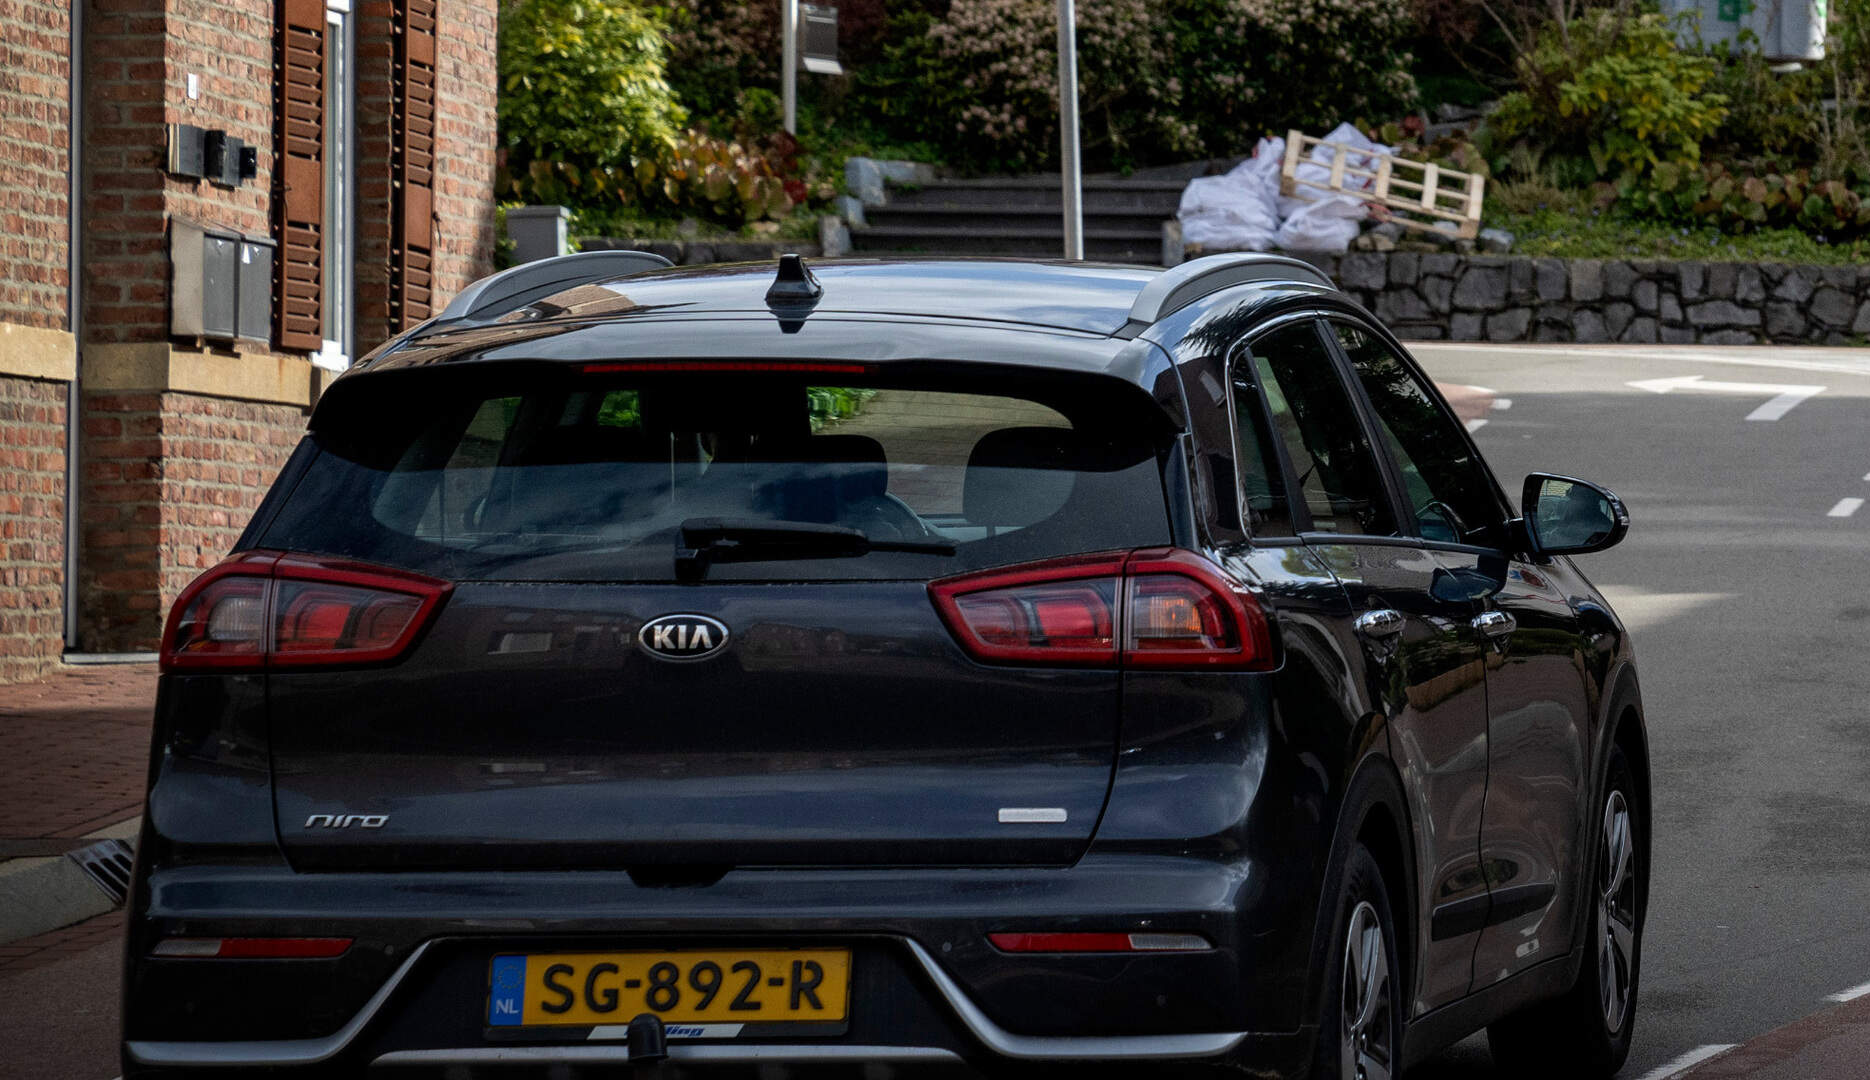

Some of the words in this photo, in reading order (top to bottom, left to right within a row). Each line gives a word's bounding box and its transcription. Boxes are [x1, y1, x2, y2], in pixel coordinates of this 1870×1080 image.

[653, 624, 713, 649] KIA
[541, 960, 824, 1013] SG-892-R
[495, 998, 519, 1014] NL
